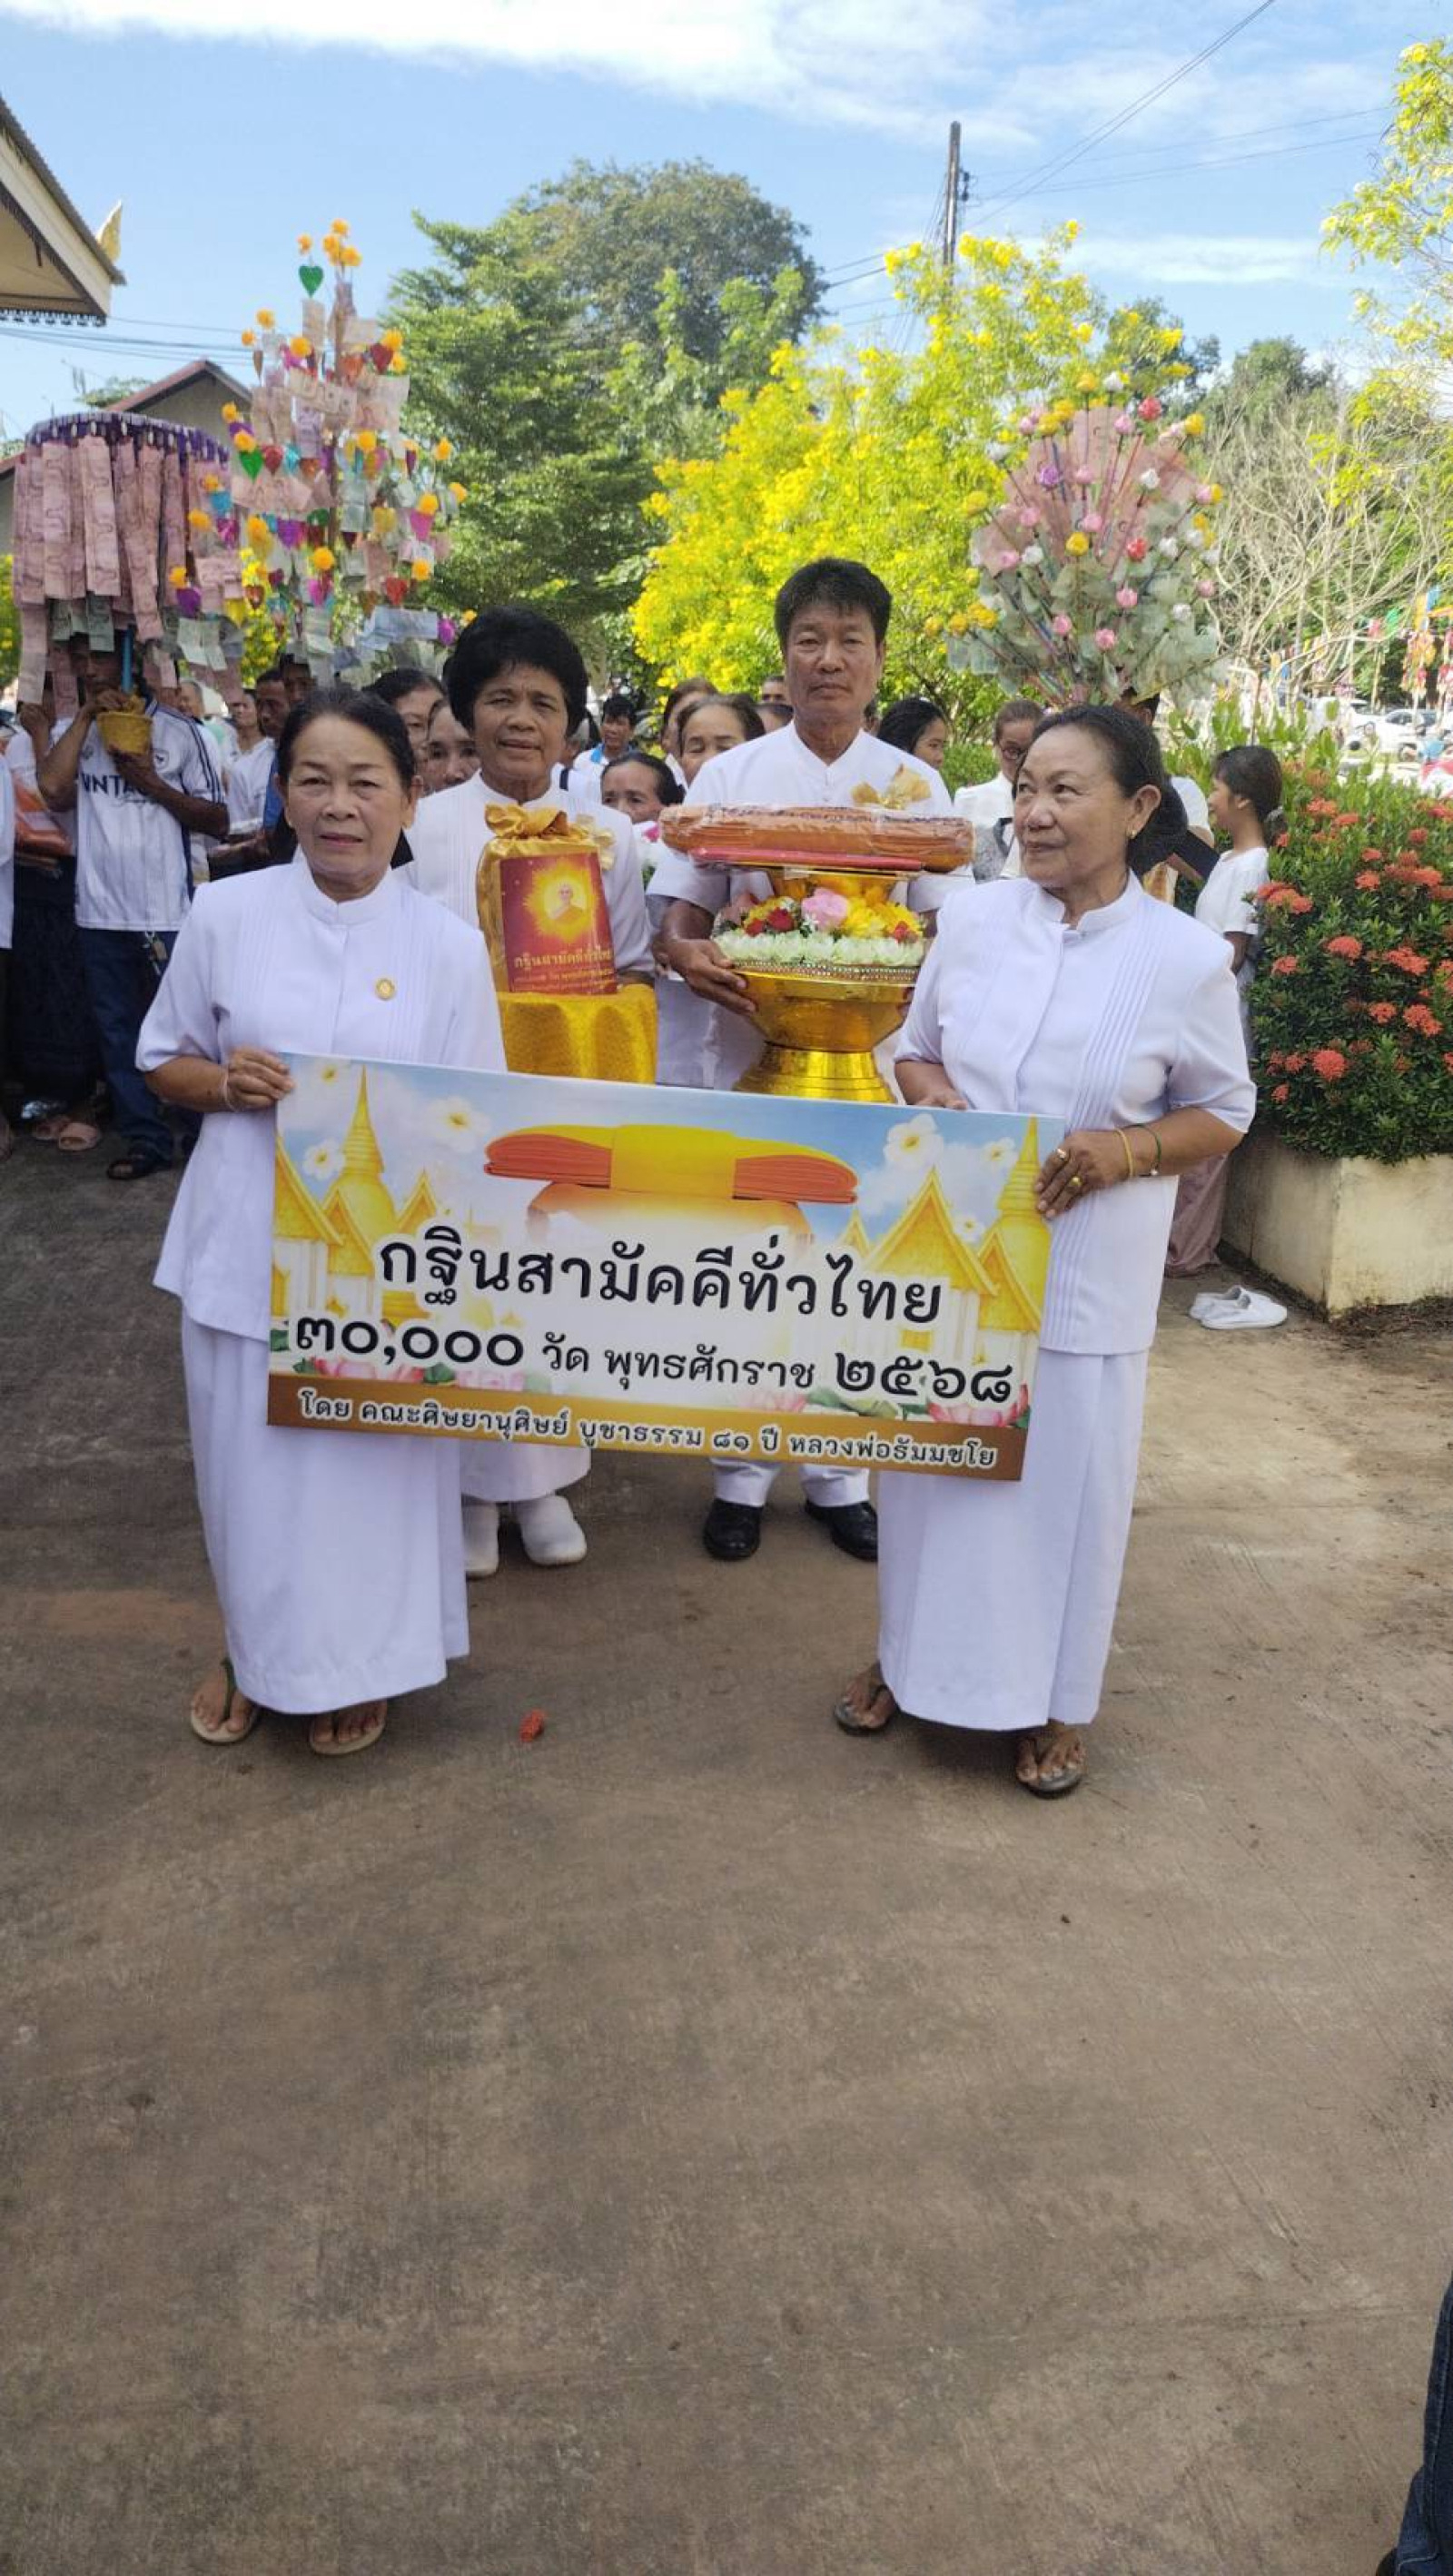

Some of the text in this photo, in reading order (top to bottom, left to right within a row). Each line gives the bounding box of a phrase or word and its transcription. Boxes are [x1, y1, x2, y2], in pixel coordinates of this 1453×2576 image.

[381, 1225, 942, 1324] กฐินสามัคคีทั่วไทย
[296, 1316, 1014, 1403] ๓๐,๐๐๐ วัด พุทธศักราช ๒๕๖๘
[300, 1390, 997, 1466] โดย คณะศิษยานุศิษย์ บูชาธรรม ๘๑ ปี หลวงพ่อธัมมชโย
